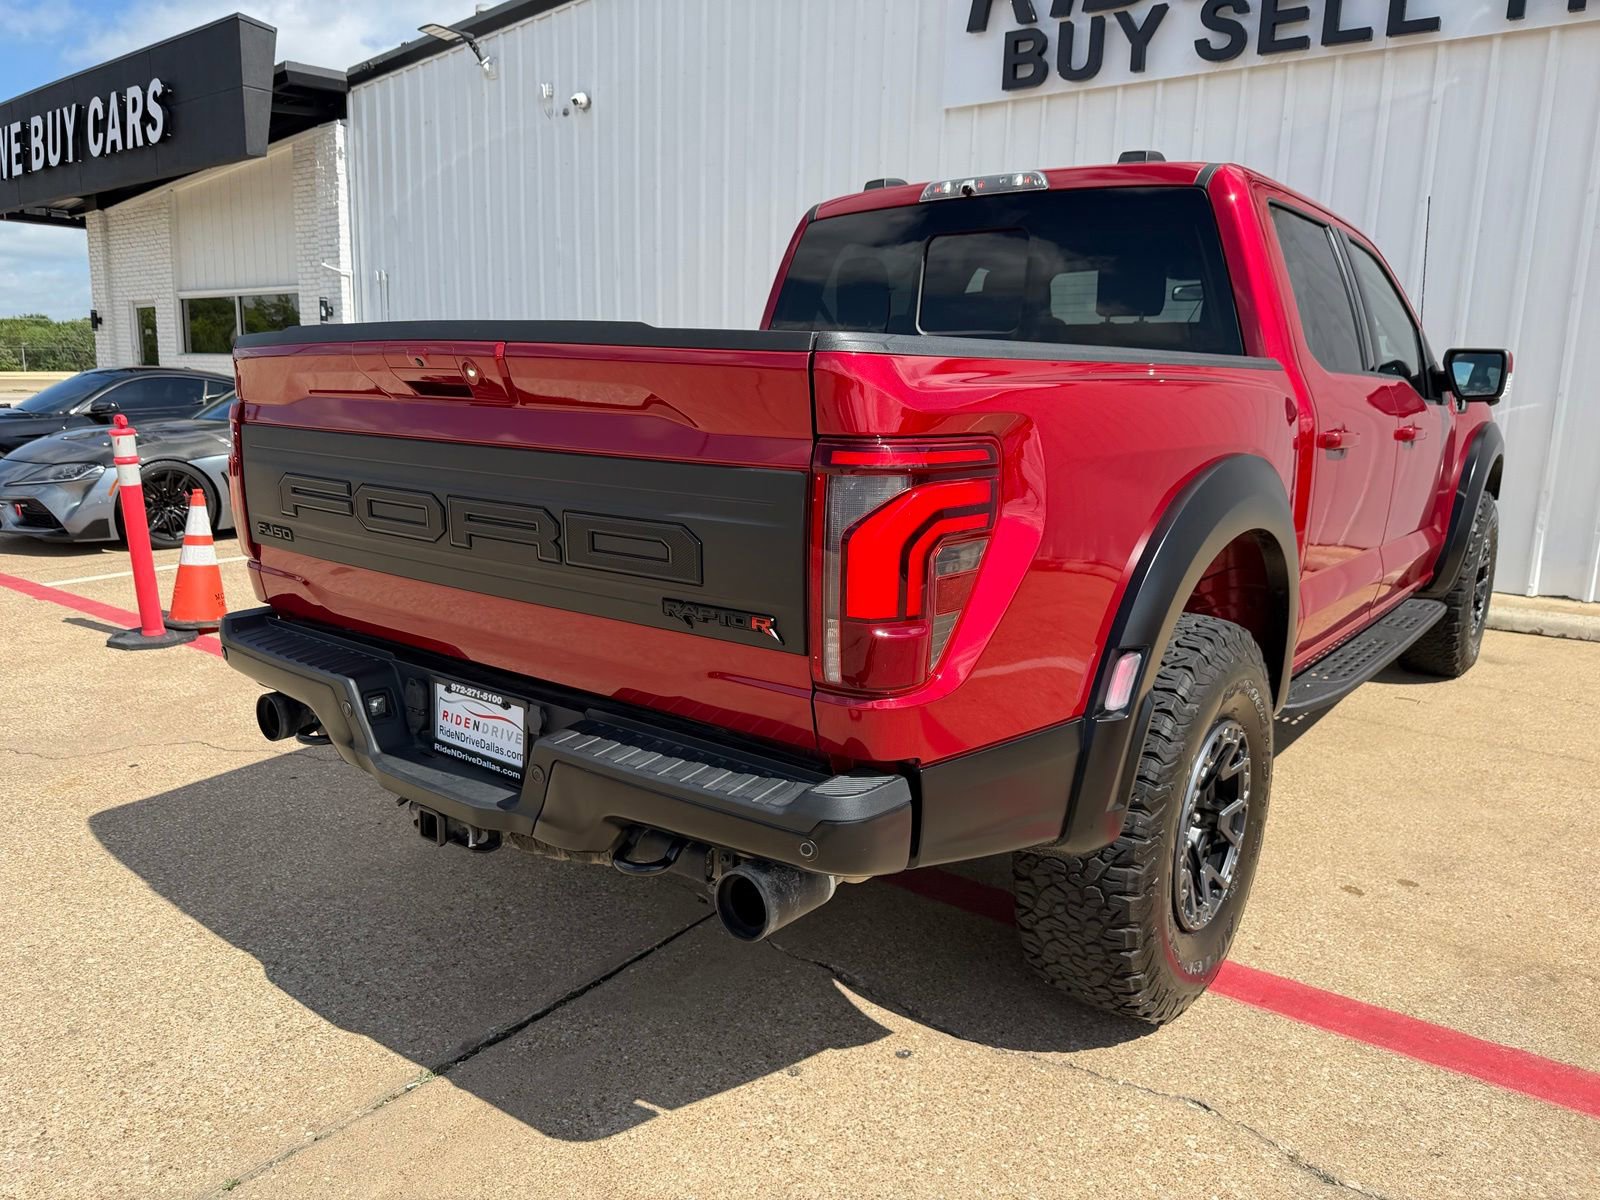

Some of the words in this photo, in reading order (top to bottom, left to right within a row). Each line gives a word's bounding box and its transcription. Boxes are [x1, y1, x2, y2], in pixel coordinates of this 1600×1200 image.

[1001, 2, 1169, 91] BUY
[1194, 0, 1441, 62] SELL
[30, 103, 76, 172] BUY
[87, 77, 164, 158] CARS
[278, 472, 704, 587] FORD
[662, 597, 784, 645] RAPTOR
[450, 683, 503, 705] 972-271-5100
[434, 743, 521, 780] RideNDriveDallas.com
